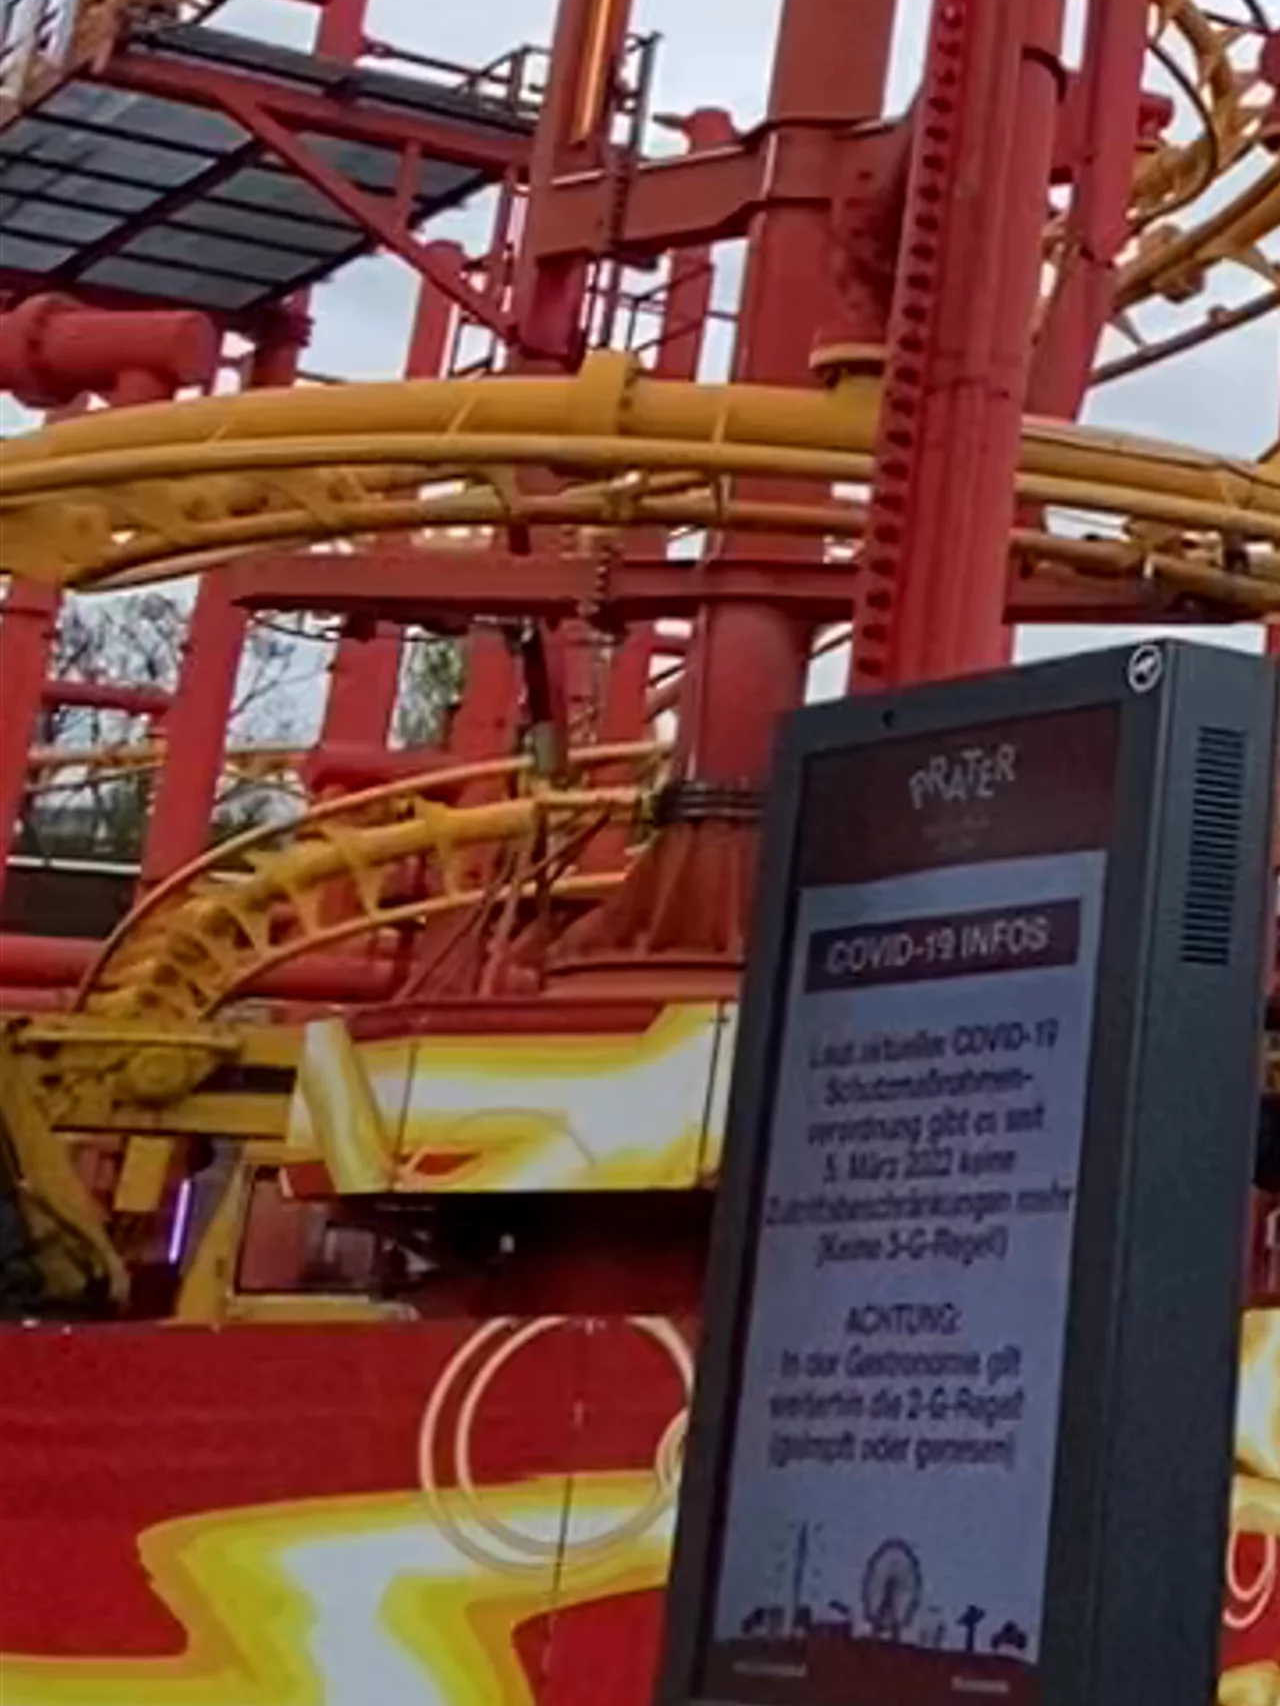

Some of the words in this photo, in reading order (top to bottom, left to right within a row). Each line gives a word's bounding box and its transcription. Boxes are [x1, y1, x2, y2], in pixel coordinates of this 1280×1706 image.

[908, 743, 1017, 810] PRATER
[824, 926, 957, 975] COVID-19
[961, 915, 1049, 959] INFOS
[952, 1017, 1060, 1057] COVID-19
